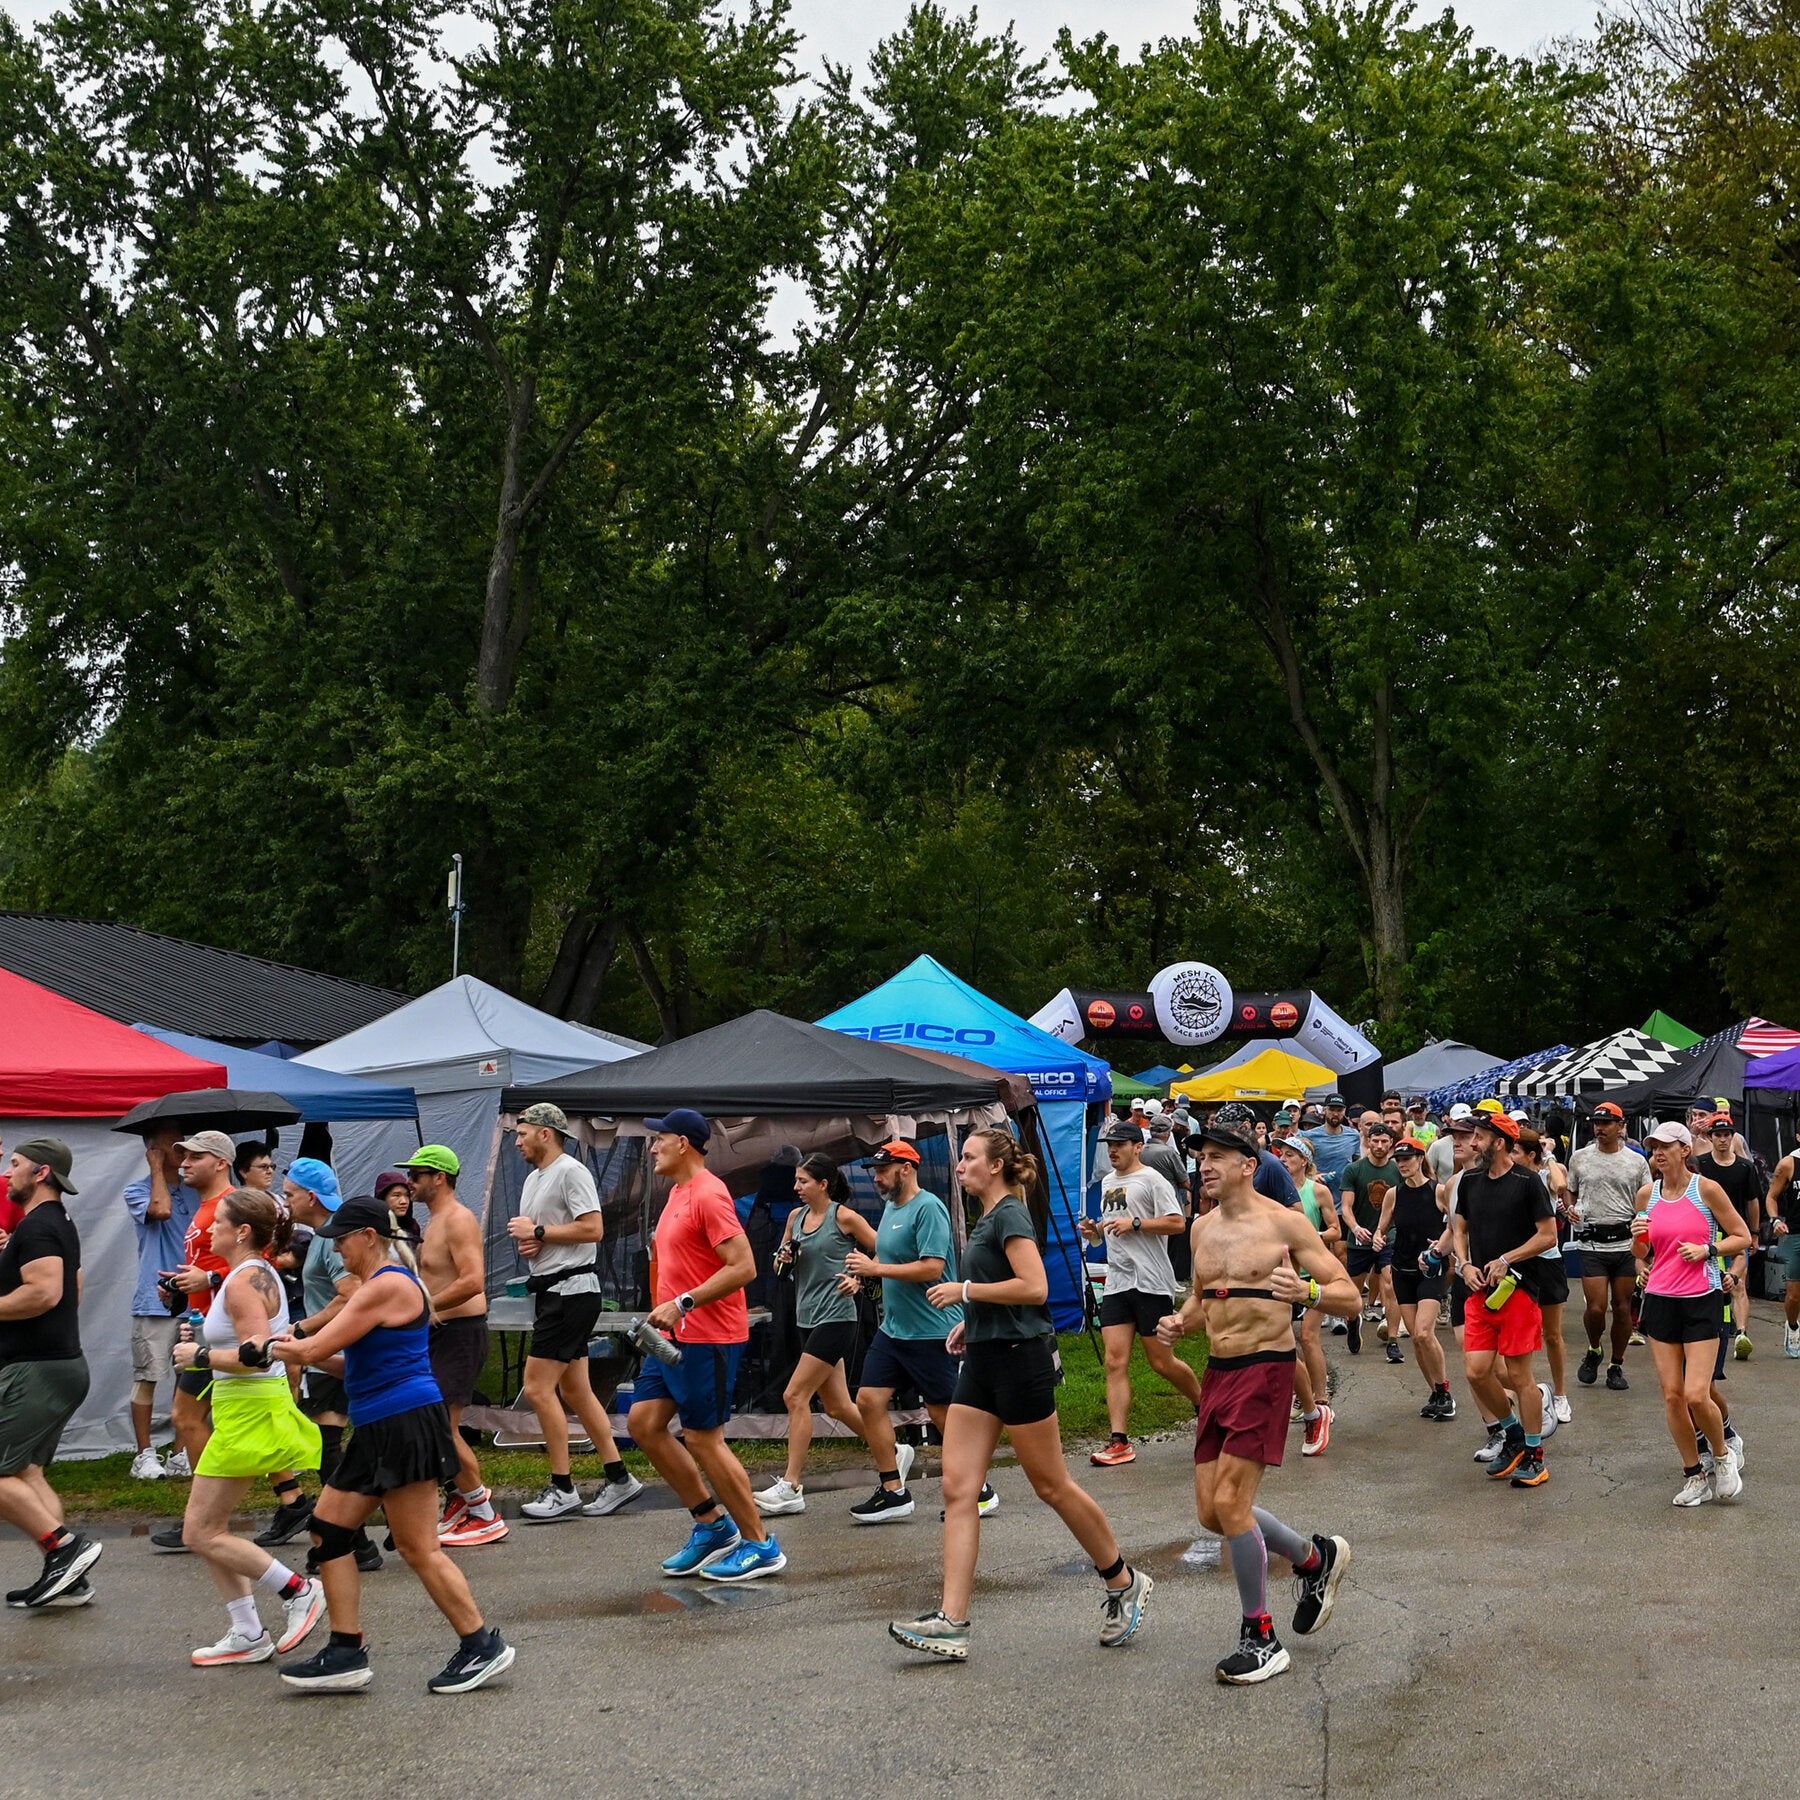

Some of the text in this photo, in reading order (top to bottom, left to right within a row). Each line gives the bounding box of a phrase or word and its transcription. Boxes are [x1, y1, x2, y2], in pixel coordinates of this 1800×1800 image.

[1173, 970, 1217, 983] MESH TC
[1173, 1025, 1192, 1037] RACE
[1194, 1026, 1220, 1038] SERIES
[1014, 1072, 1075, 1084] EICO
[741, 1553, 760, 1568] HOKA
